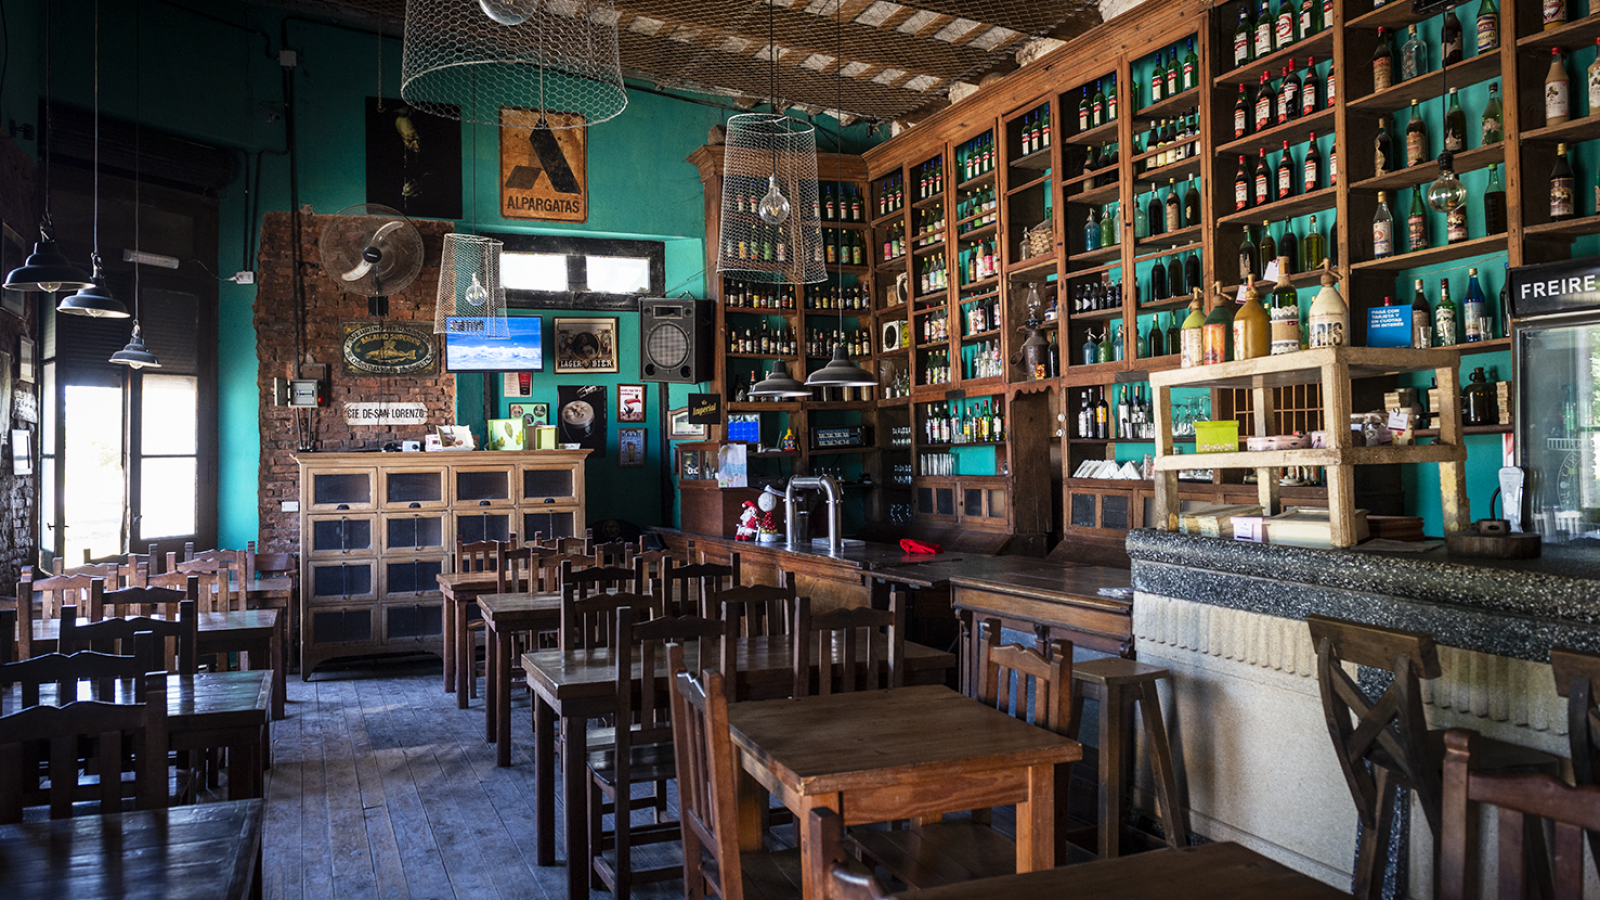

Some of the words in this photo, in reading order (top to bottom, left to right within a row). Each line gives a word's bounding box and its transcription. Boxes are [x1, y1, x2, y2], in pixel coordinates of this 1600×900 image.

[507, 195, 580, 213] ALPARGATAS
[1521, 274, 1596, 299] FREIRE
[390, 333, 421, 346] SUPERIOR
[592, 360, 612, 368] BIER
[362, 408, 372, 419] DE
[391, 408, 424, 418] LORENZO
[692, 403, 717, 416] Imperial
